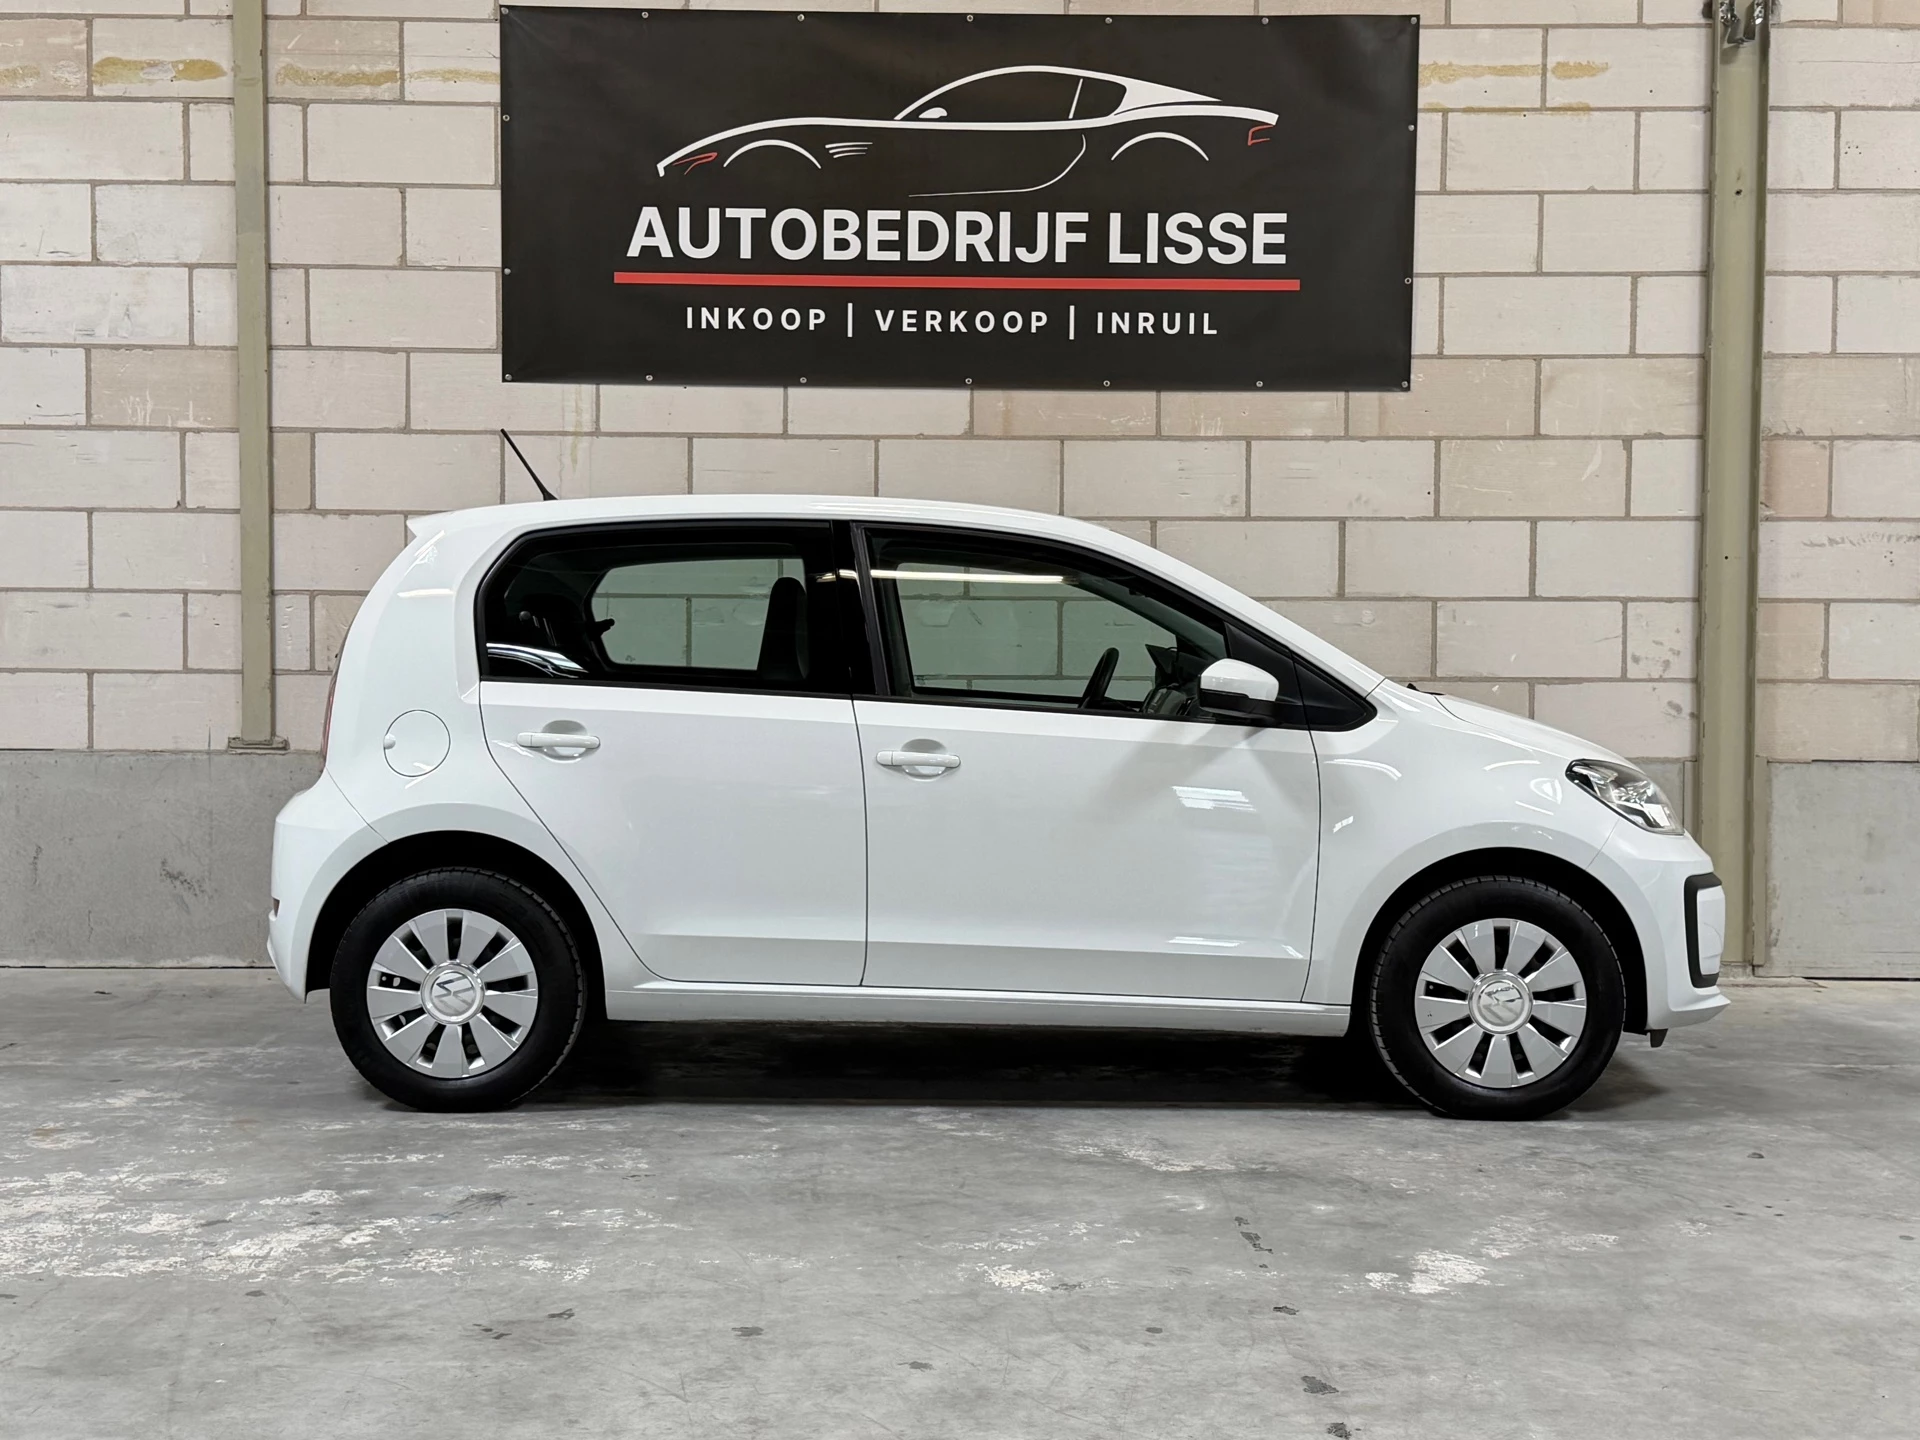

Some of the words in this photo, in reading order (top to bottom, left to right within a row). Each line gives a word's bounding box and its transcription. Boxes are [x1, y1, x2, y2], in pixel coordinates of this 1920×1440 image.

[627, 206, 1089, 264] AUTOBEDRIJF
[1108, 212, 1288, 265] LISSE
[686, 306, 826, 331] INKOOP
[874, 309, 1048, 334] VERKOOP
[1096, 311, 1218, 335] INRUIL
